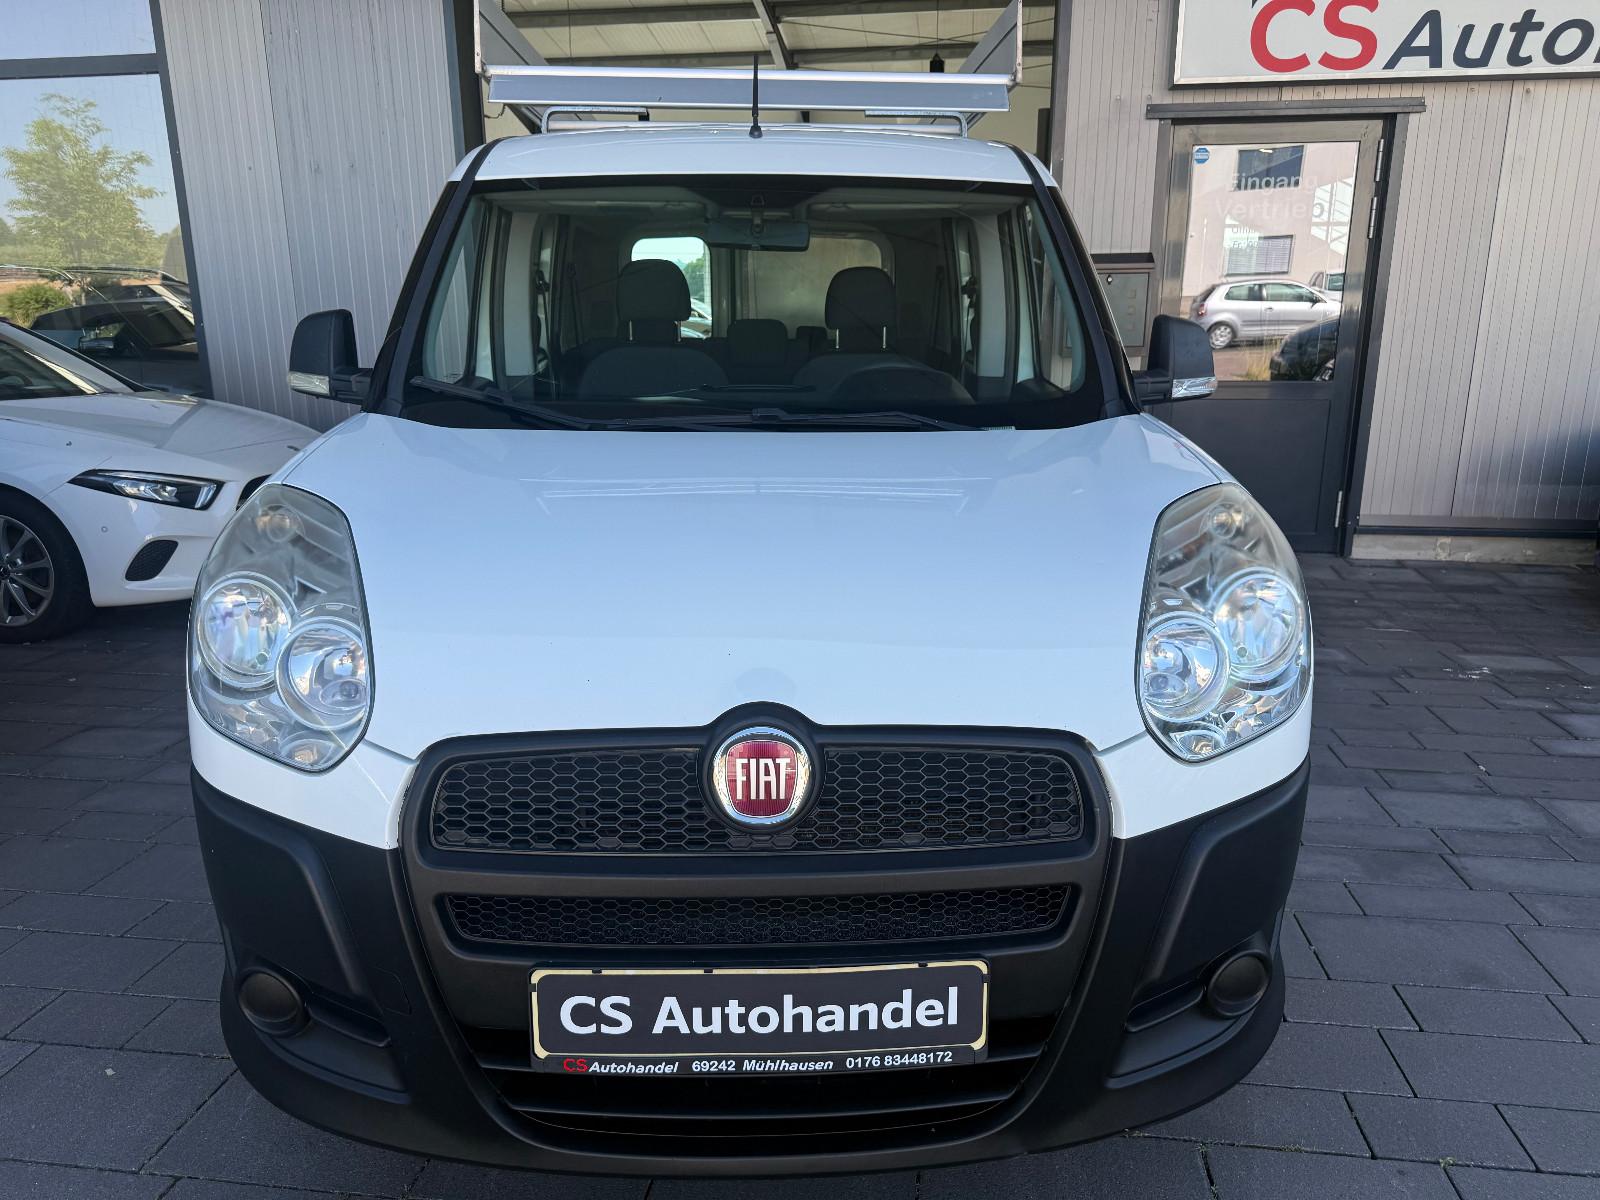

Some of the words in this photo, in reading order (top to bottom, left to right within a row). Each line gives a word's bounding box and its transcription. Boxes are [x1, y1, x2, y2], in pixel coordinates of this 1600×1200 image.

[1250, 0, 1379, 73] CS
[1382, 9, 1600, 70] Auto
[1231, 172, 1317, 196] Eingang
[736, 758, 790, 800] FIAT
[560, 995, 633, 1035] CS
[651, 986, 958, 1035] Autohandel
[691, 1059, 736, 1072] 69242
[742, 1059, 834, 1071] Mühlhausen
[845, 1055, 881, 1069] 0176
[883, 1050, 953, 1067] 83448172
